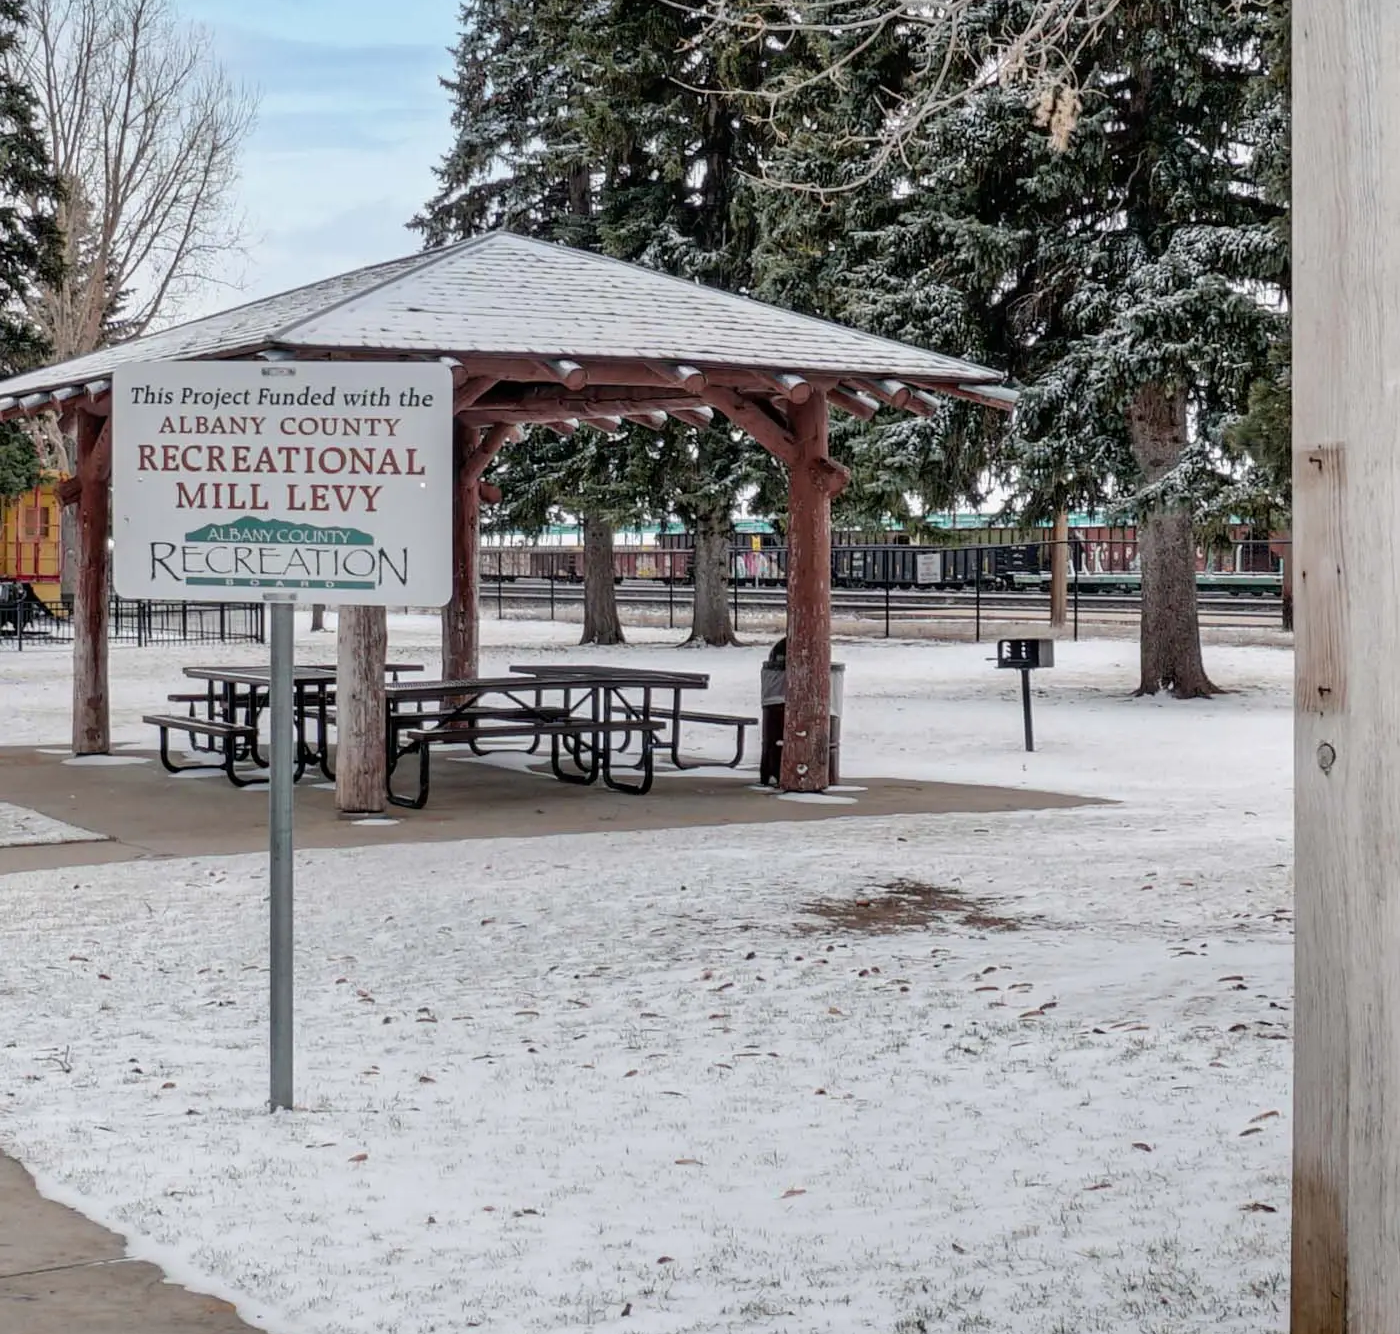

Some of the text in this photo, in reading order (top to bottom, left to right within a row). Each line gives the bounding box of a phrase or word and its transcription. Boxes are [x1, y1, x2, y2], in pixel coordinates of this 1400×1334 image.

[131, 385, 434, 410] This Project Funded with the
[158, 416, 401, 437] ALBANY COUNTY
[138, 444, 426, 476] RECREATIONAL
[176, 482, 383, 512] MILL LEVY
[207, 527, 350, 544] ALBANY COUNTY
[150, 541, 407, 586] RECREATION
[225, 578, 335, 588] BOARD
